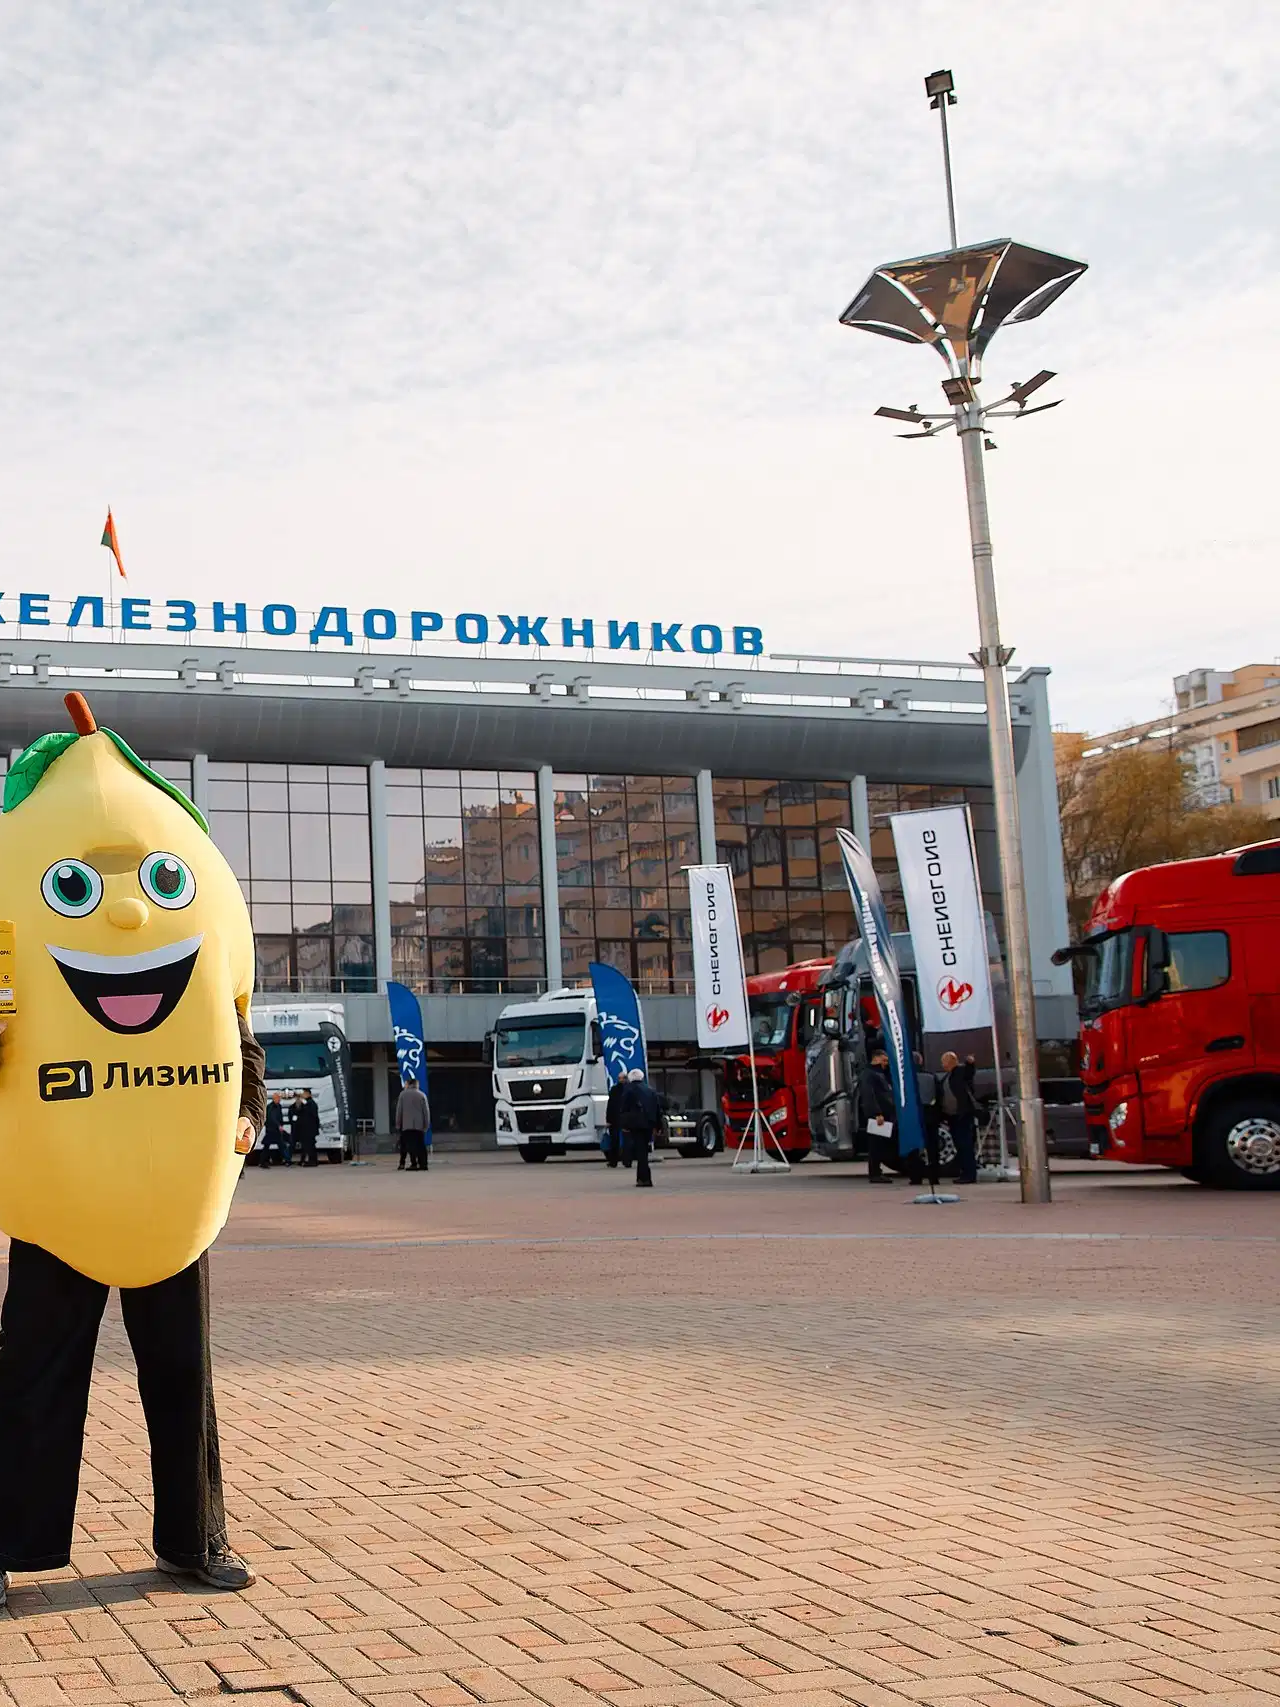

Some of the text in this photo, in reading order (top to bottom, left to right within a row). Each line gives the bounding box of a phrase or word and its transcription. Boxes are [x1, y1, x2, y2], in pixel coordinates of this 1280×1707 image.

[706, 882, 721, 995] CHENGLONG
[922, 829, 958, 967] CHENGLONG
[103, 1062, 235, 1090] Лизинг
